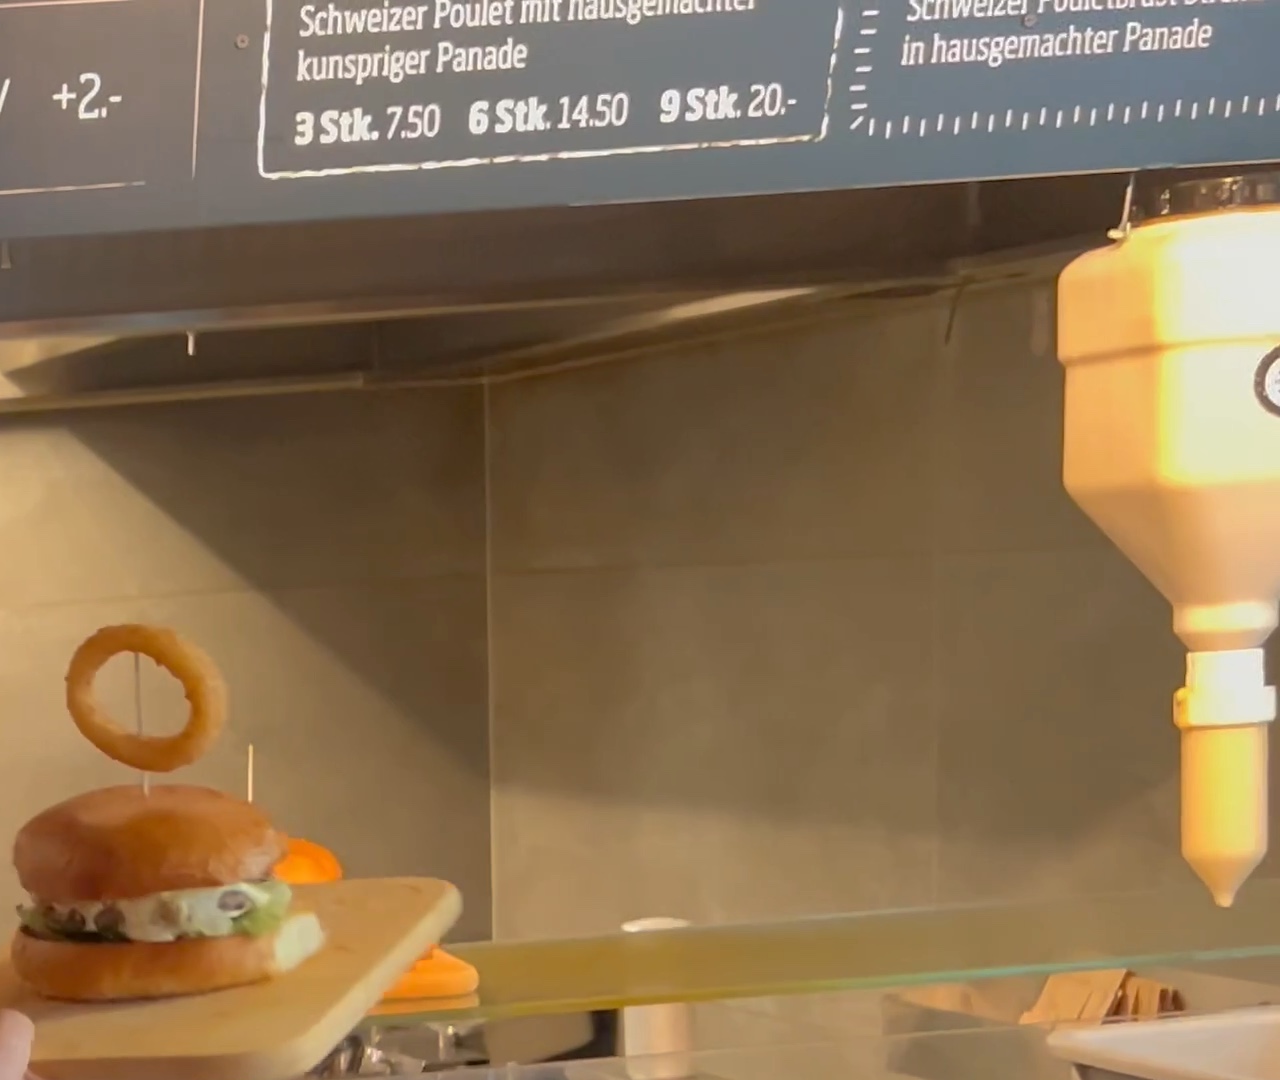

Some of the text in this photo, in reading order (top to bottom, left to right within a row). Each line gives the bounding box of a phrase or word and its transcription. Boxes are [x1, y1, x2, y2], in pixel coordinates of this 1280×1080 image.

[298, 2, 424, 37] Schweizer
[433, 0, 513, 29] Poulet
[519, 0, 561, 23] mit
[900, 18, 1213, 67] in hausgemachter Panade
[296, 38, 528, 85] kunspriger Panade
[51, 72, 124, 121] +2.-
[295, 81, 797, 146] 3 Stk. 7.50 6 Stk. 14.50 9 Stk. 20.-
